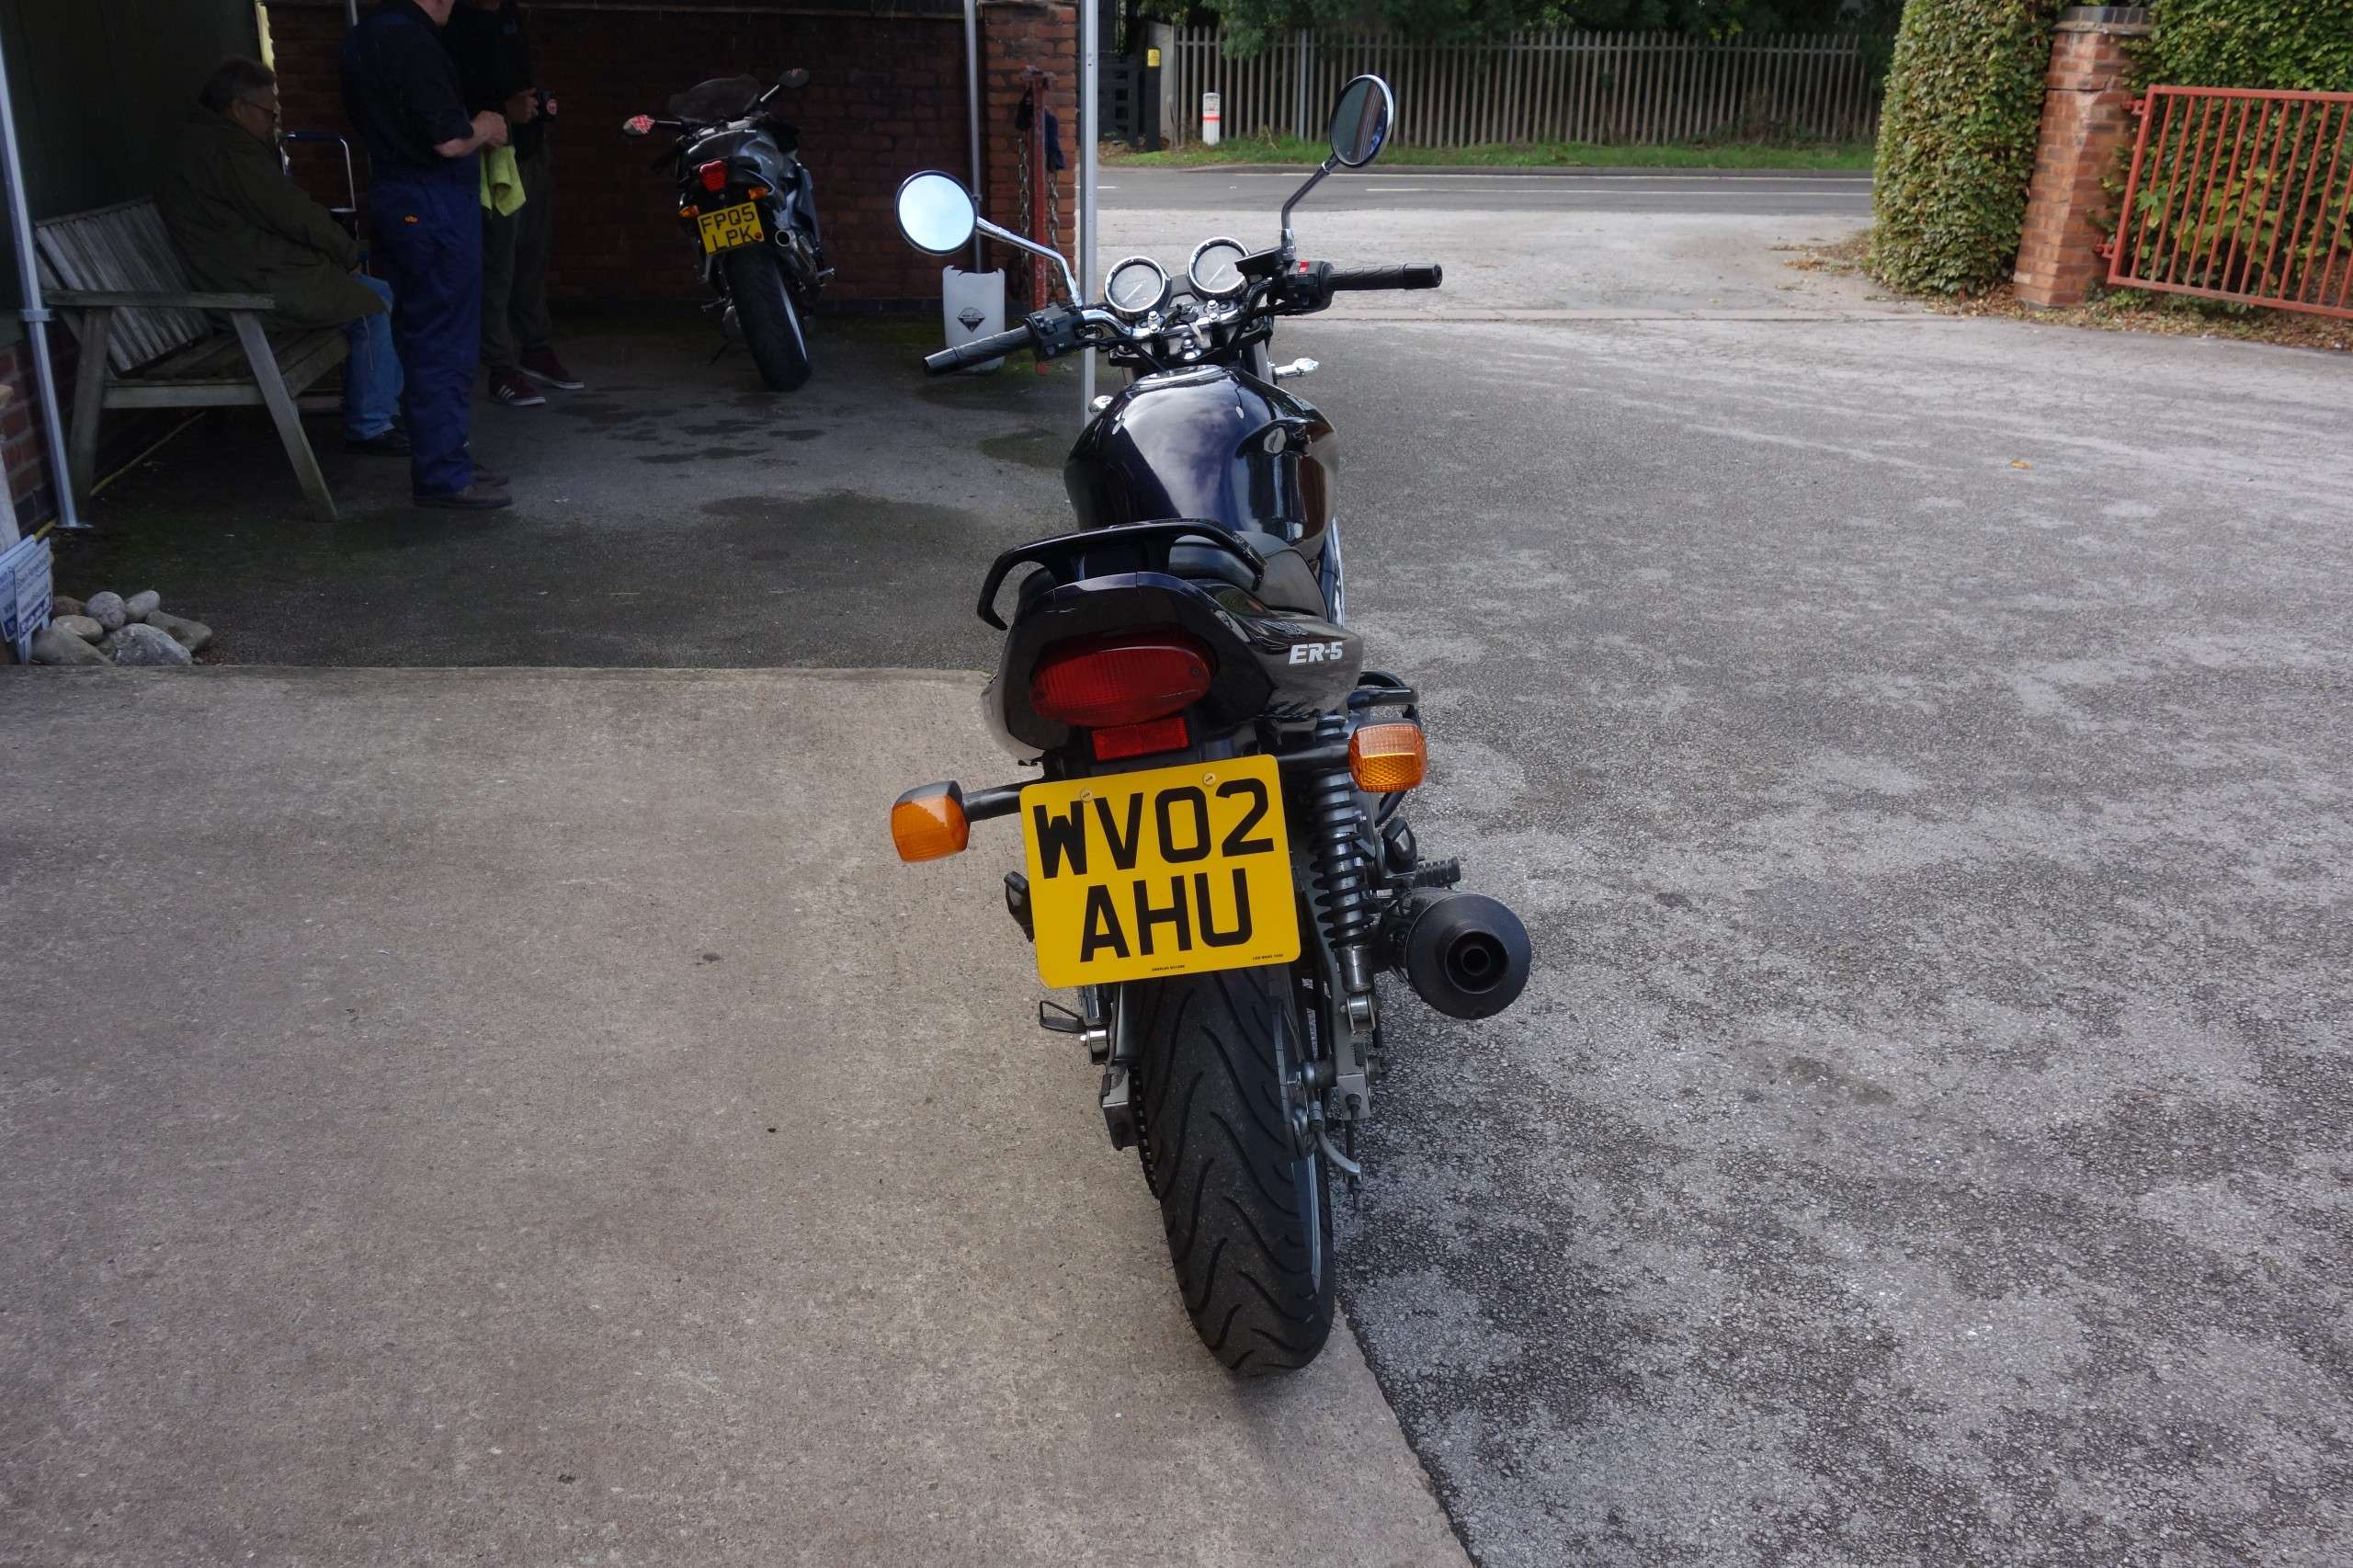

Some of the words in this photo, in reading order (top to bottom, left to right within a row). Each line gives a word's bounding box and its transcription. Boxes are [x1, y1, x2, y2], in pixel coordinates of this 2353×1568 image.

[1289, 641, 1344, 665] ER-5
[1032, 778, 1275, 880] WV02
[1079, 868, 1253, 963] AHU
